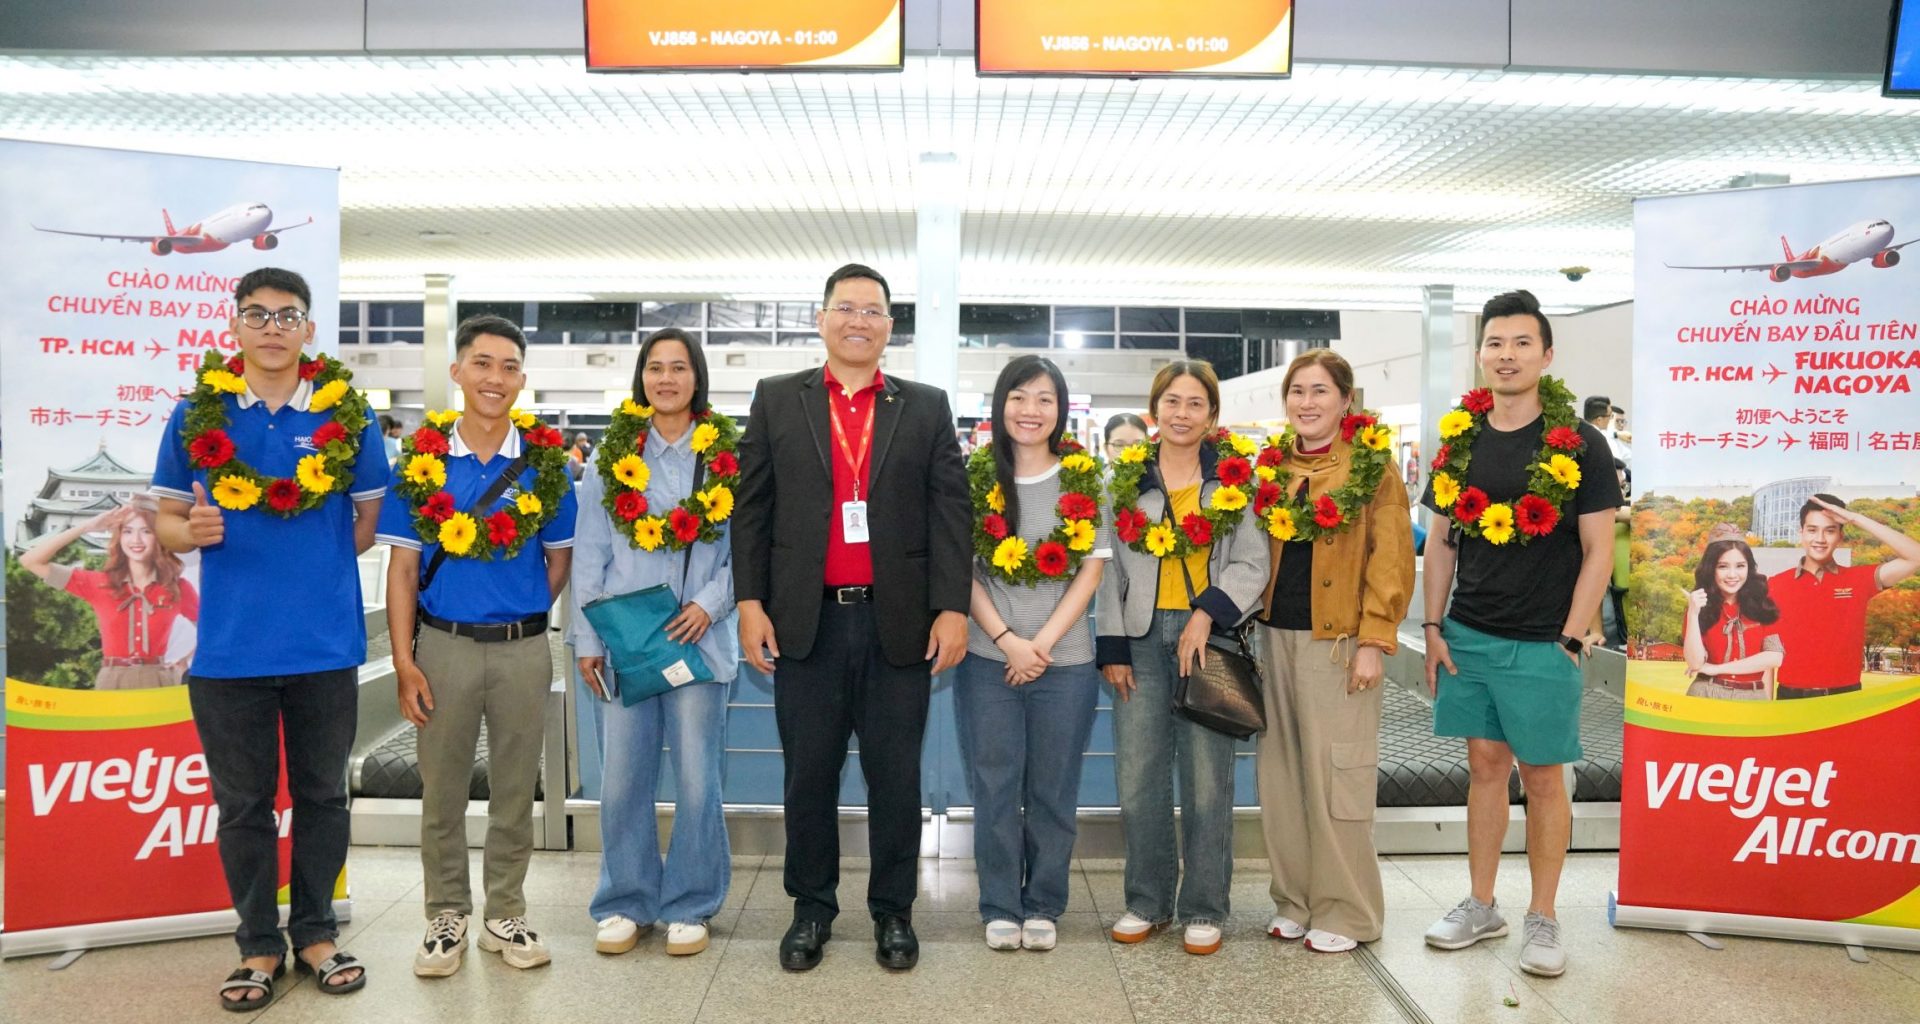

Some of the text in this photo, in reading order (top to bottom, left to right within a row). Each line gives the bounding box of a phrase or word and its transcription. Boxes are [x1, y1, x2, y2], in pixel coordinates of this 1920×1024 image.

[710, 30, 782, 45] NAGOYA
[794, 30, 838, 45] 01:00
[1102, 36, 1174, 51] NAGOYA
[1185, 37, 1229, 52] 01:00
[107, 268, 169, 290] CHÀO
[47, 292, 142, 316] CHUYẾN
[149, 300, 192, 318] BAY
[1729, 293, 1860, 316] CHÀO MỪNG
[177, 328, 242, 351] NAG
[1677, 319, 1918, 343] CHUYẾN BAY ĐẦU TIÊN
[39, 338, 135, 356] TP. HCM
[1794, 350, 1920, 370] FUKUOKA
[1668, 366, 1754, 382] TP. HCM
[1794, 374, 1911, 396] NAGOYA
[30, 406, 152, 427] 市ホーチミン
[1736, 408, 1849, 425] 初便へようこそ
[1658, 431, 1769, 450] 市ホーチミン
[1809, 431, 1849, 450] 福岡
[28, 747, 210, 817] Vietje
